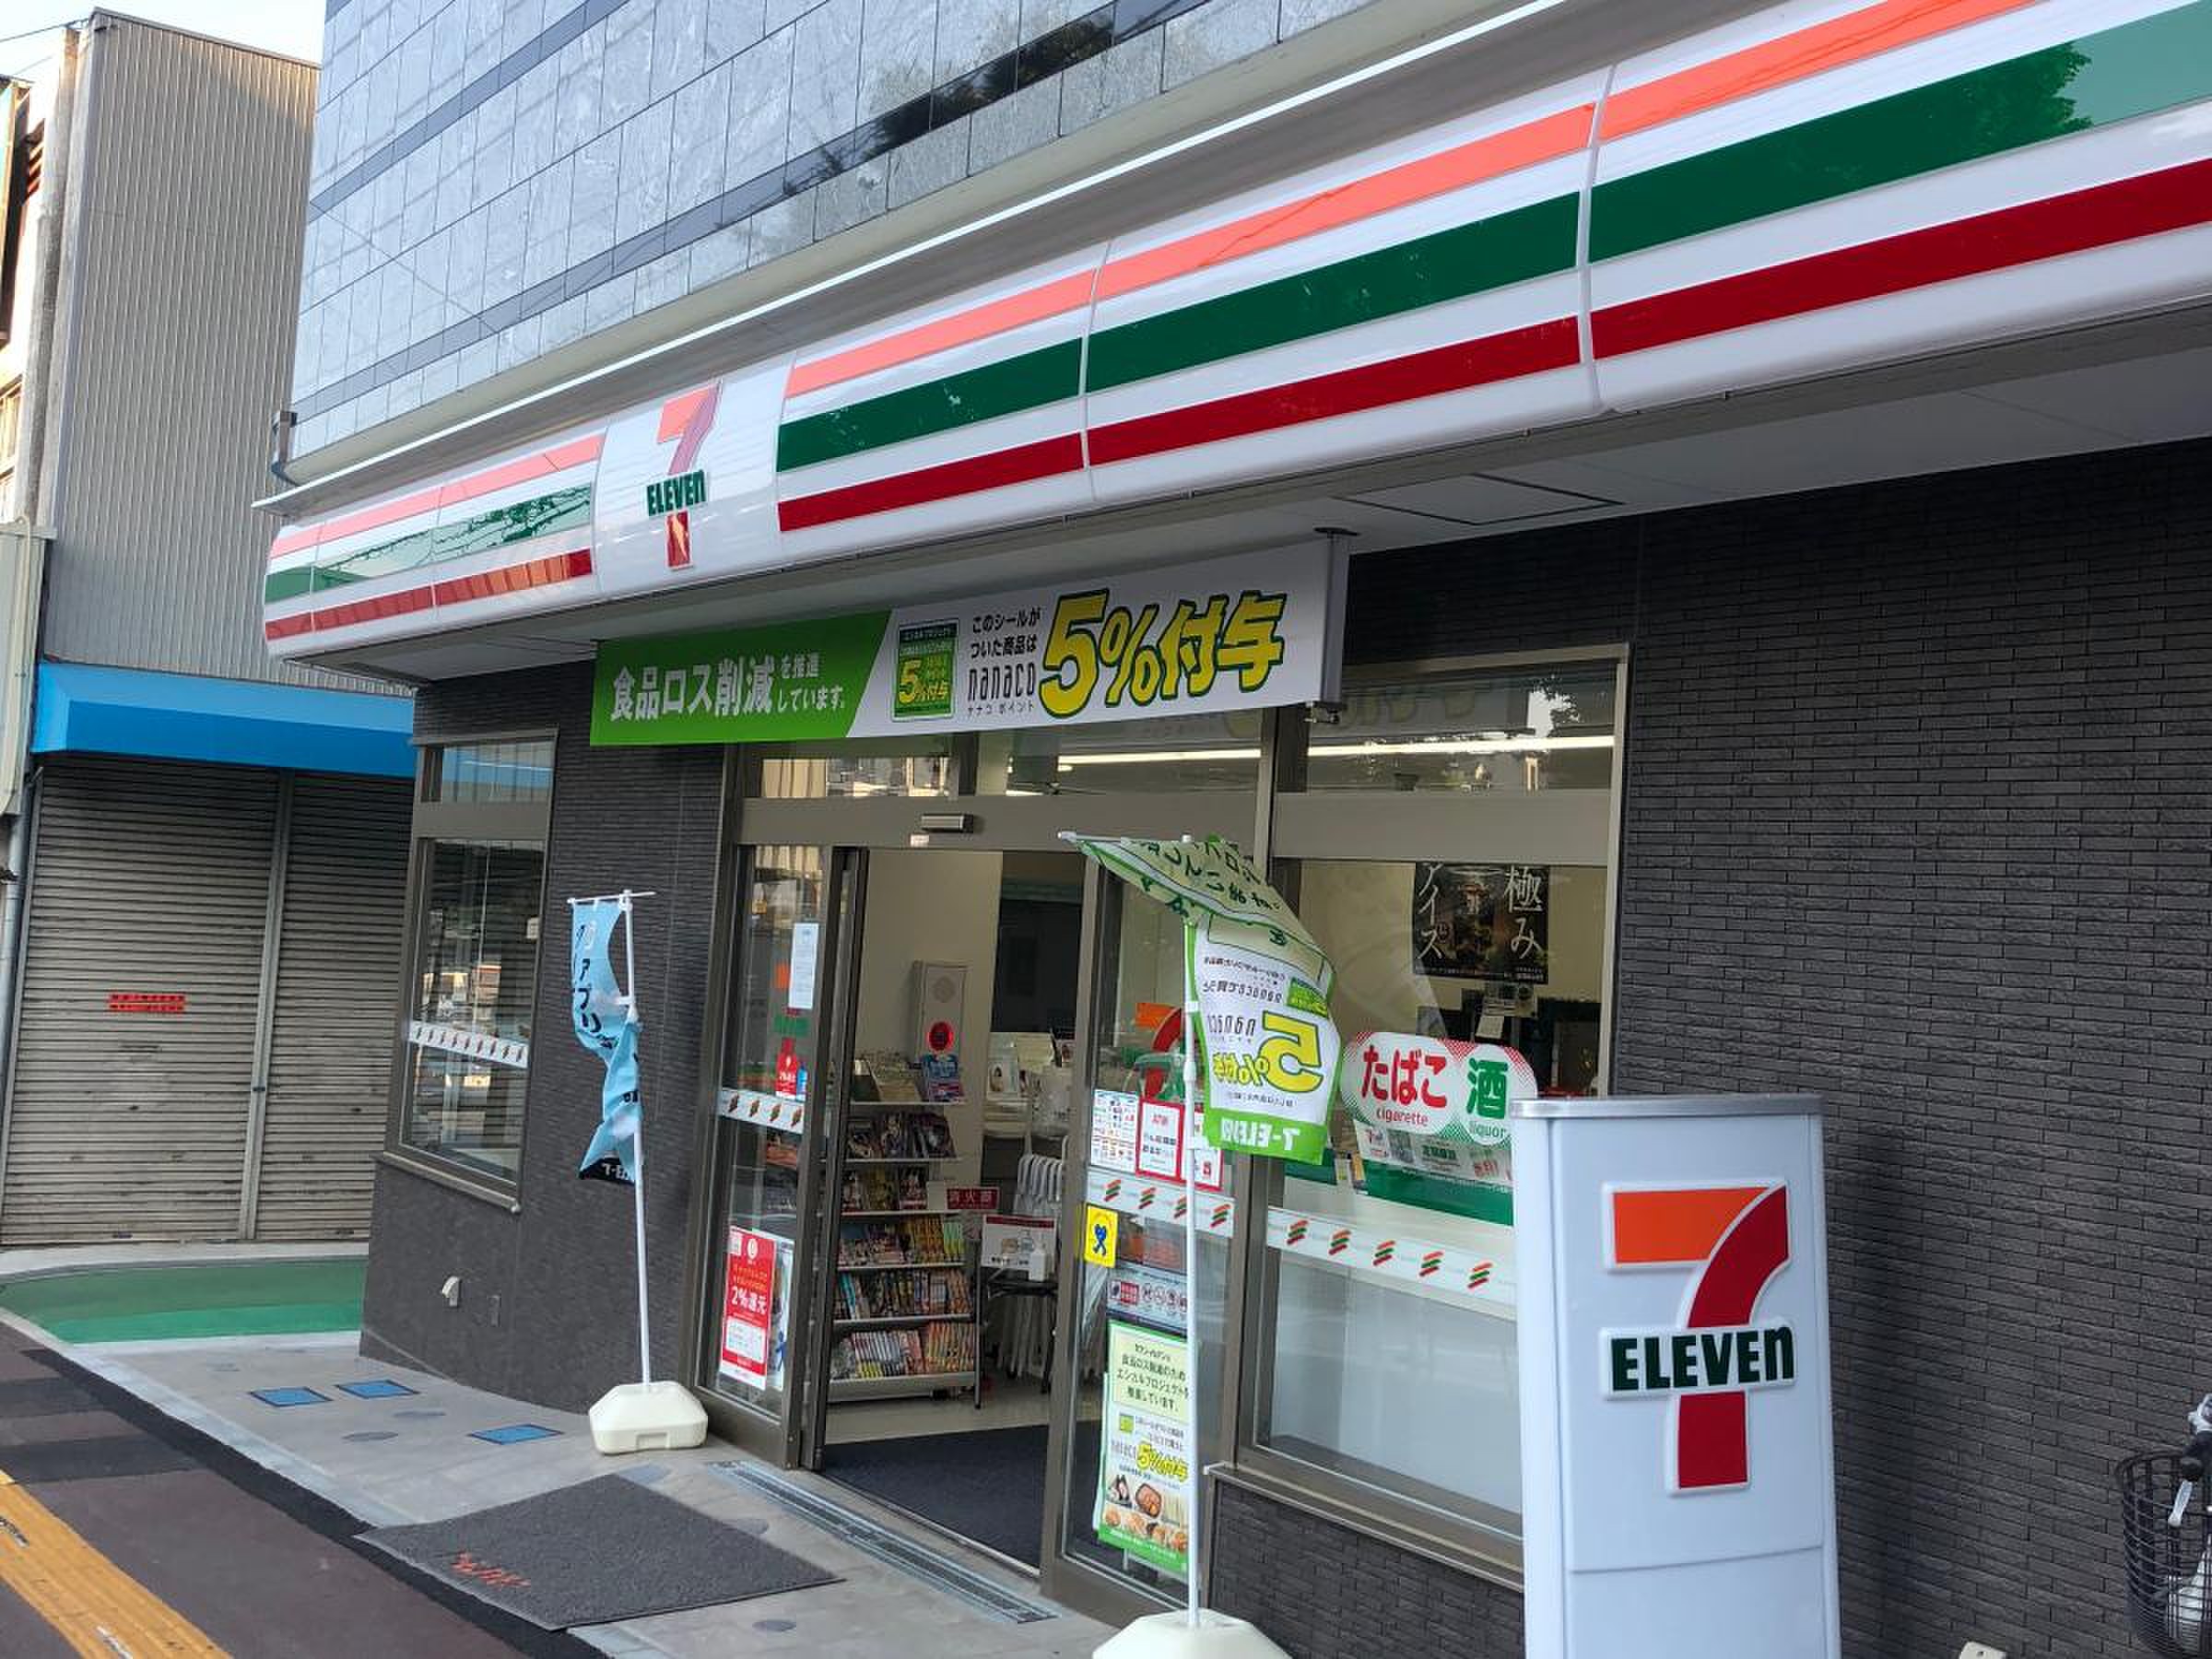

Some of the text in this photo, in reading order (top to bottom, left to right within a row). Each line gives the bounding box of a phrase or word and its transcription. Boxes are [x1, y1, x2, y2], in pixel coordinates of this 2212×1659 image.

[972, 606, 1041, 634] このシールが
[781, 653, 820, 679] を推進
[971, 633, 1038, 659] ついた商品は
[1039, 588, 1287, 719] 5%付与
[610, 655, 775, 722] 食品ロス削減
[777, 684, 846, 713] しています。
[968, 662, 1036, 701] nanaco
[1418, 863, 1444, 959] アイス
[1504, 865, 1545, 959] 極み
[1361, 1044, 1447, 1108] たばこ
[1466, 1057, 1509, 1120] 酒
[1376, 1108, 1429, 1127] cigarette
